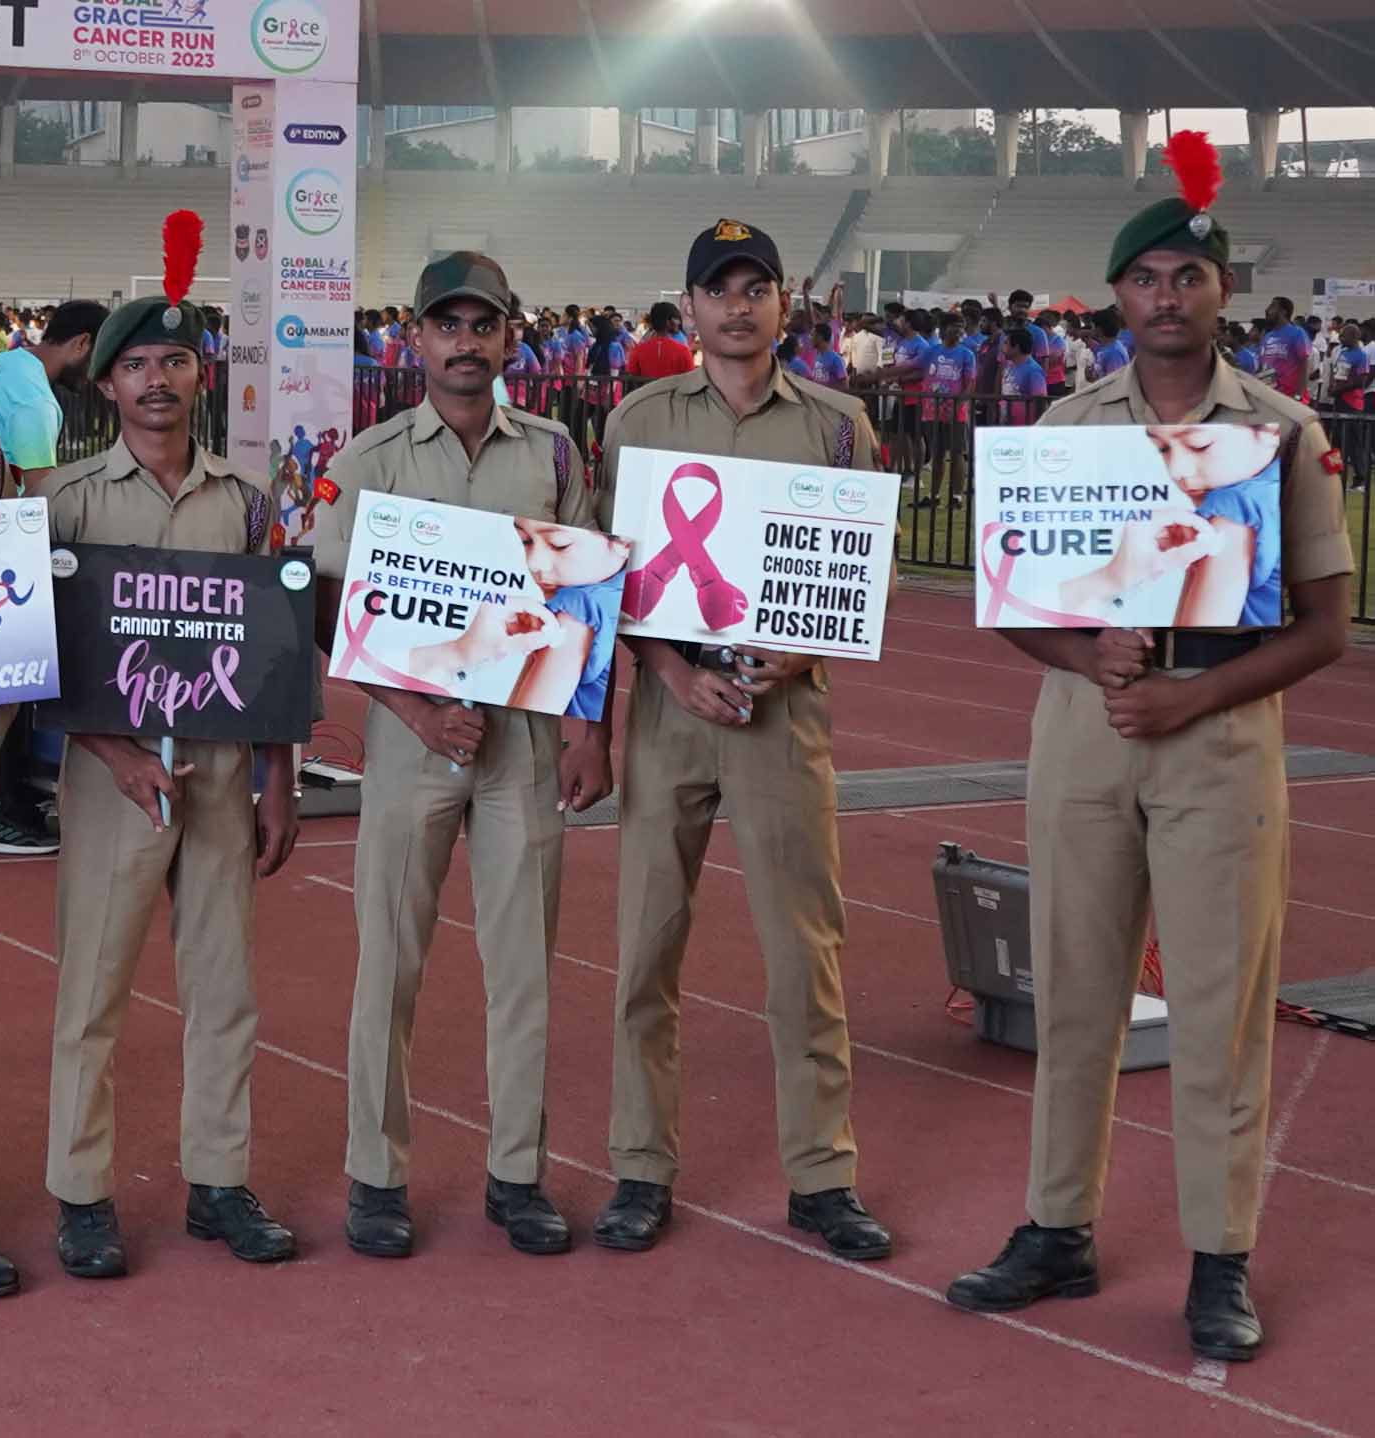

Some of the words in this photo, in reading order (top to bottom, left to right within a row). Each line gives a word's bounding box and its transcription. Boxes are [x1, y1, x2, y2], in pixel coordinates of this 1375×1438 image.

[74, 6, 162, 27] GRACE
[73, 26, 165, 48] CANCER
[171, 32, 215, 50] RUN
[73, 48, 91, 61] 8th
[95, 50, 166, 65] OCTOBER
[171, 52, 215, 68] 2023
[303, 129, 340, 140] EDITION
[281, 257, 325, 268] GLOBAL
[281, 269, 323, 279] GRACE
[281, 280, 326, 291] CANCER
[329, 281, 351, 291] RUN
[329, 292, 351, 301] 2023
[287, 326, 349, 337] QUAMBIANT
[999, 484, 1169, 503] PREVENTION
[1000, 511, 1016, 522] IS
[1022, 510, 1096, 522] BETTER
[1100, 510, 1152, 522] THAN
[765, 523, 822, 552] ONCE
[831, 529, 872, 556] YOU
[1000, 528, 1114, 556] CURE
[370, 549, 526, 590] PREVENTION
[763, 555, 822, 577] CHOOSE
[113, 572, 244, 615] CANCER
[367, 571, 383, 584] IS
[388, 575, 454, 596] BETTER
[460, 587, 506, 606] THAN
[761, 580, 866, 613] ANYTHING
[364, 590, 469, 630] CURE
[110, 615, 170, 637] CANNOT
[175, 620, 244, 641] SHATTER
[755, 608, 870, 645] POSSIBLE.
[105, 640, 217, 728] hope
